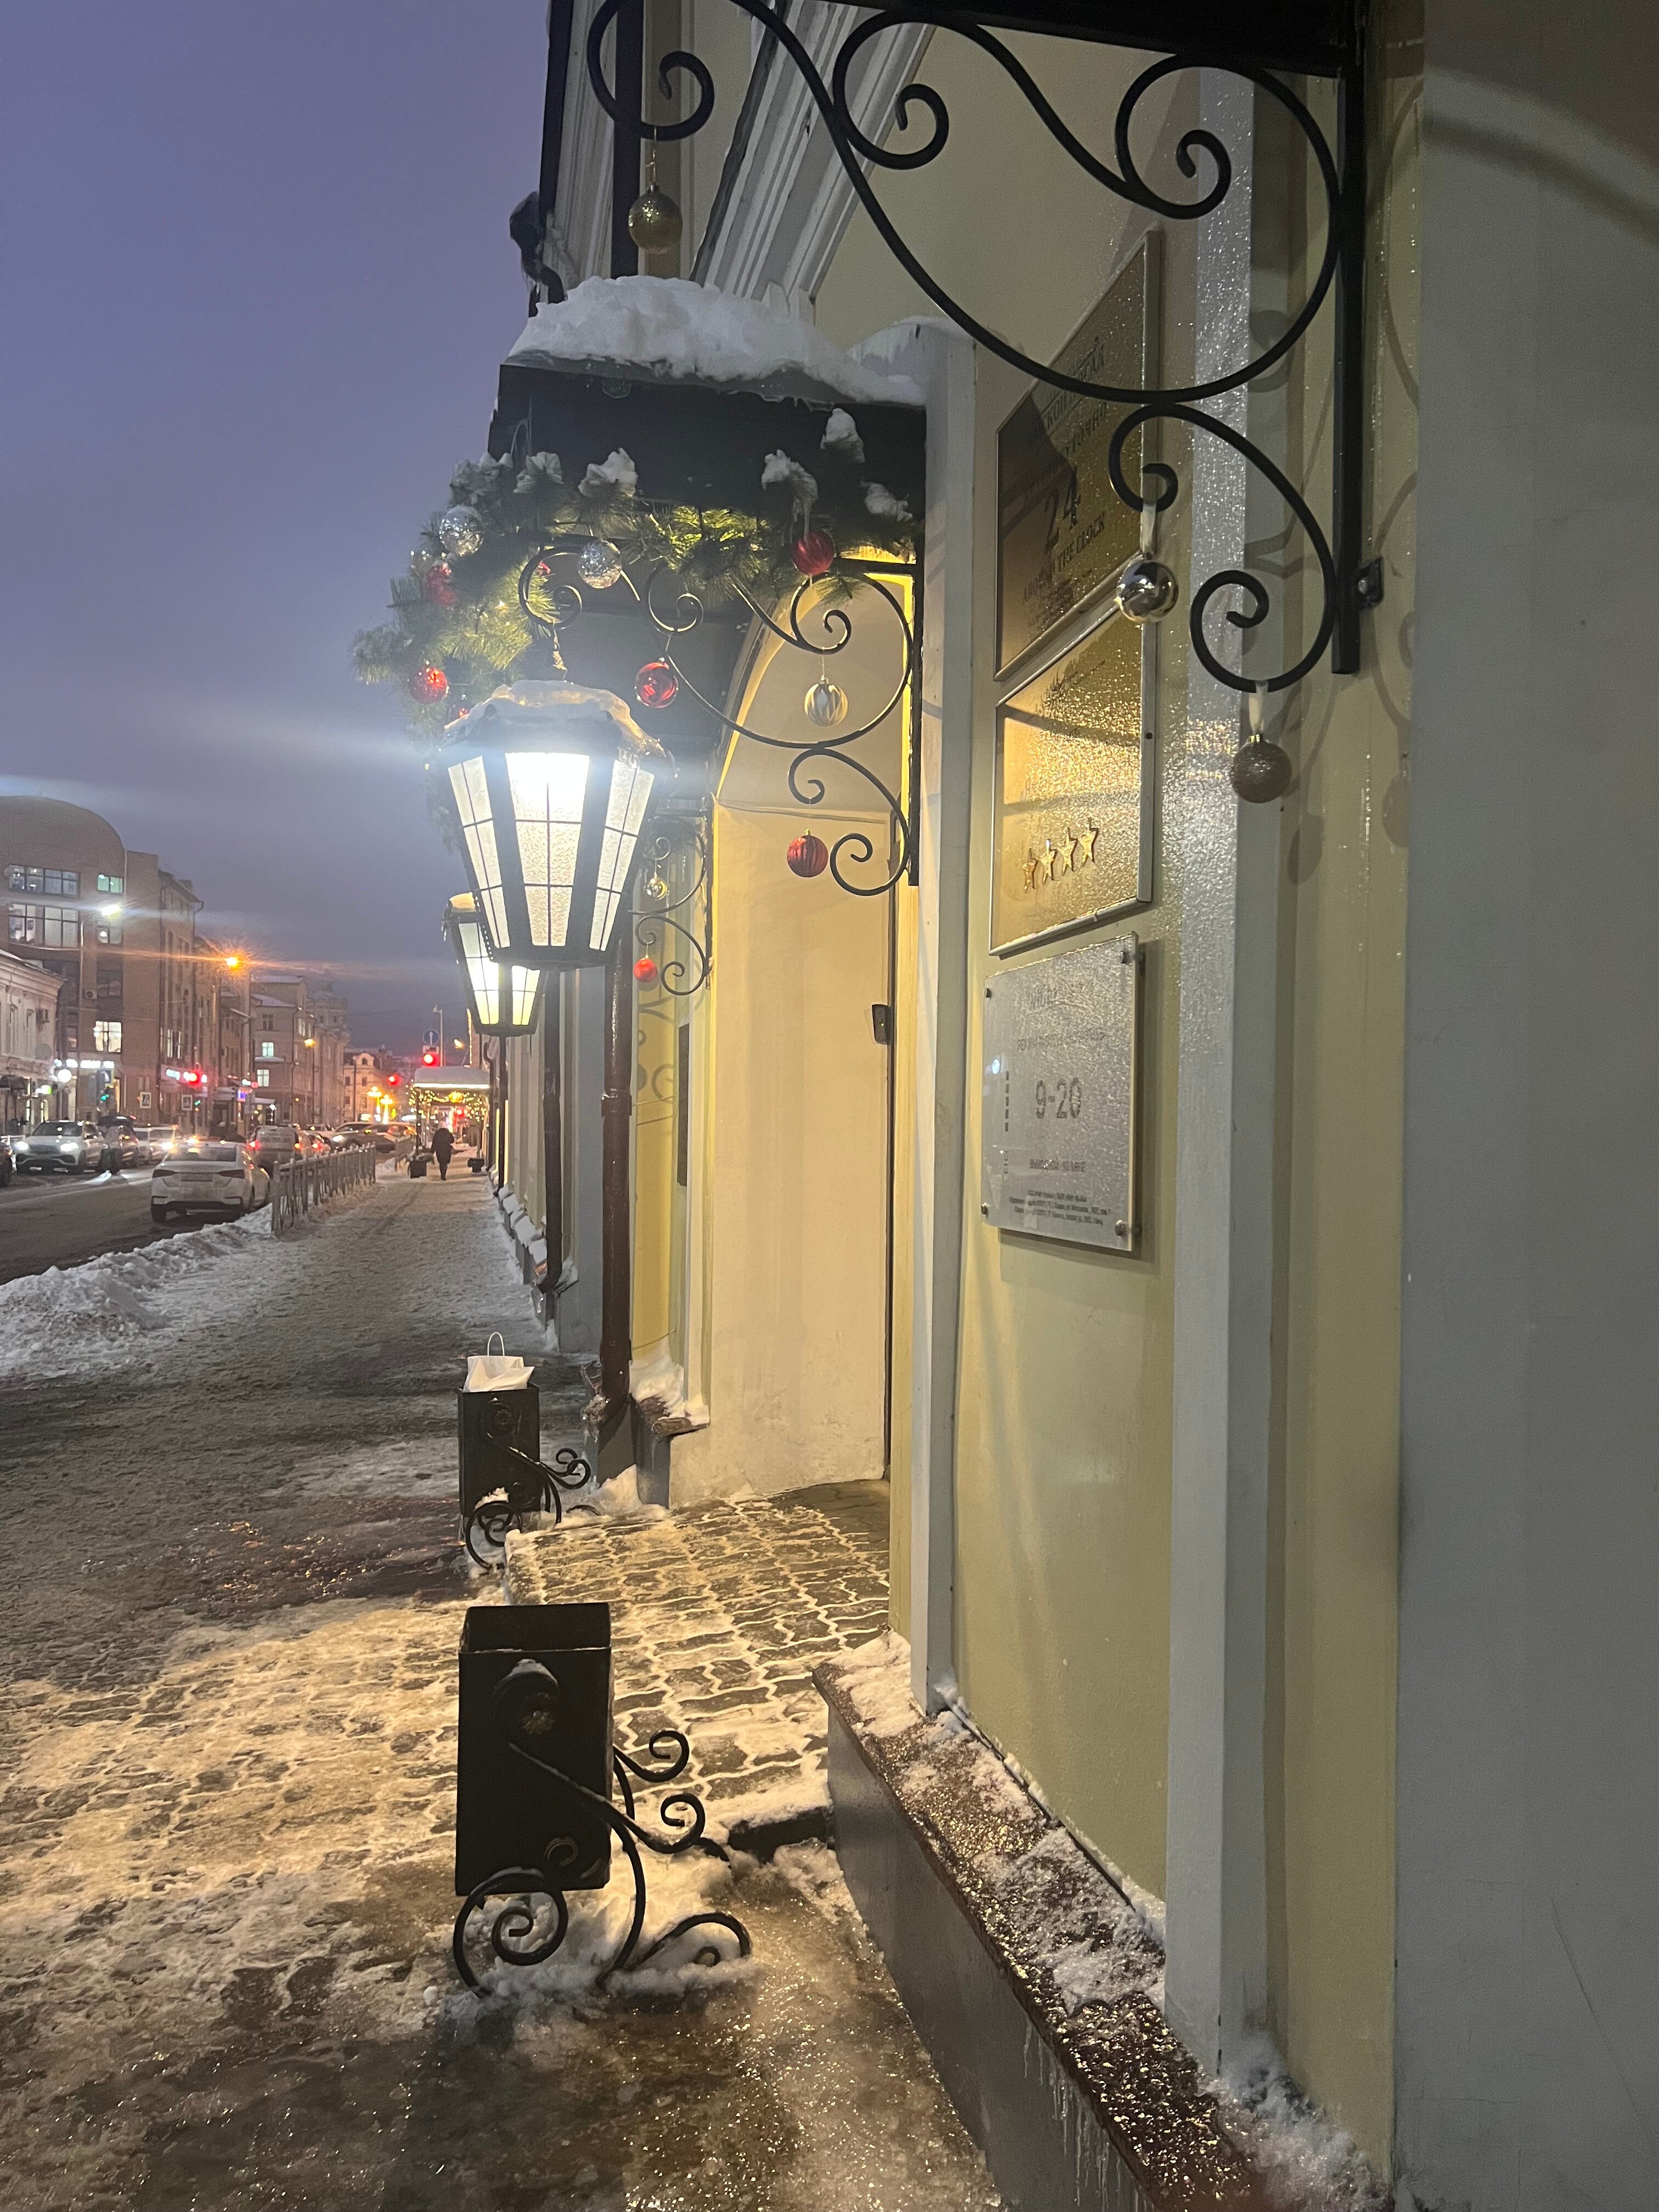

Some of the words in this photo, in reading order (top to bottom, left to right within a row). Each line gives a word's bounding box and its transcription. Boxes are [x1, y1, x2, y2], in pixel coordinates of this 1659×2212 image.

[1045, 466, 1081, 551] 24
[1057, 540, 1076, 572] THE
[1076, 512, 1105, 554] CLOCK
